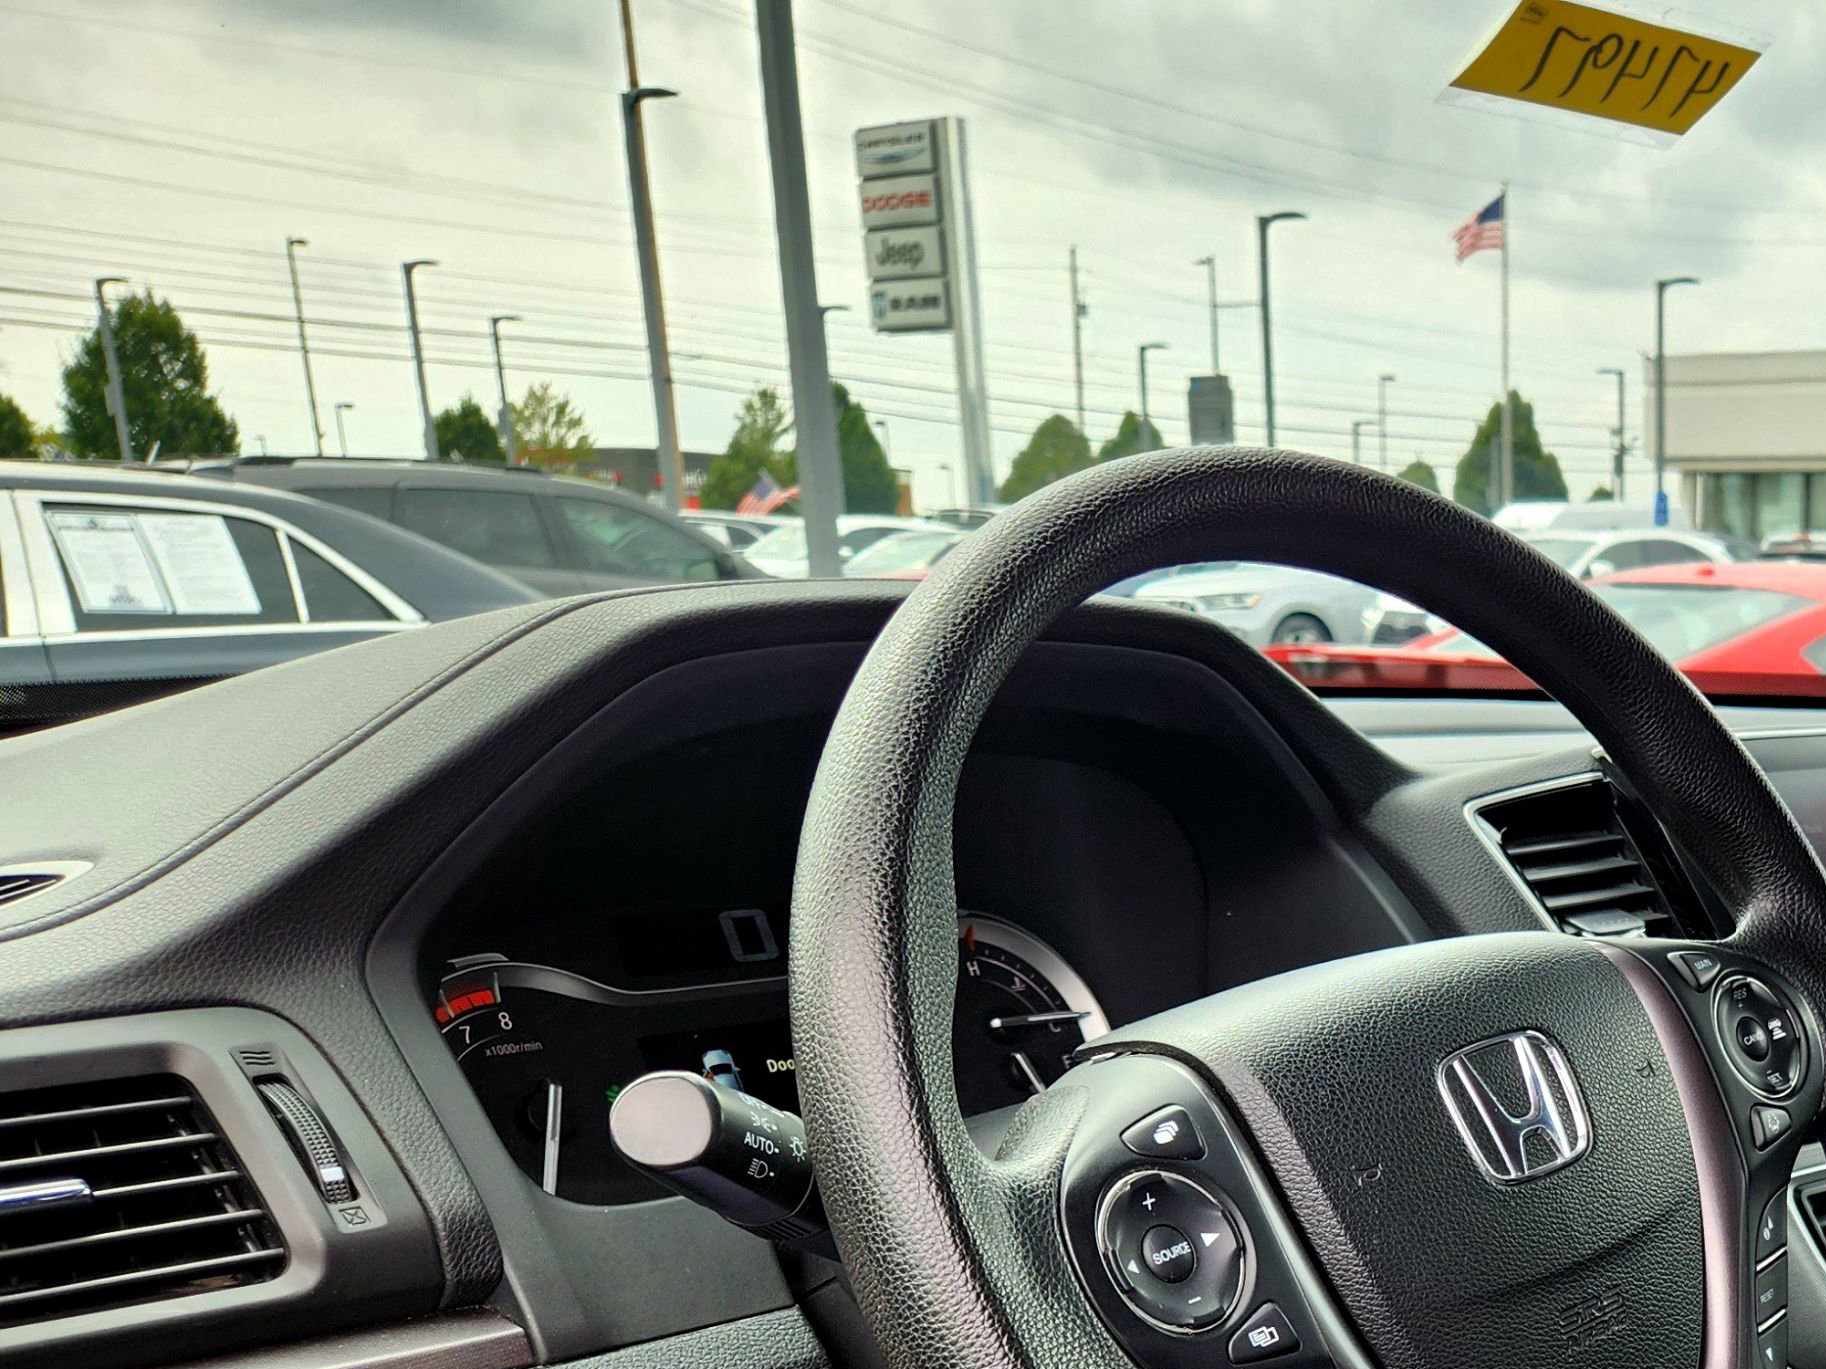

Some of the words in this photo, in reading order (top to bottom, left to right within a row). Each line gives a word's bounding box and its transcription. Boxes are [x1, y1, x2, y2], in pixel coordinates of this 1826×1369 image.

[876, 237, 925, 269] Jeep
[966, 960, 981, 976] H
[498, 1011, 513, 1030] 8
[458, 1025, 471, 1044] 7
[744, 1131, 774, 1155] AUTO
[1152, 1241, 1191, 1265] SOURCE
